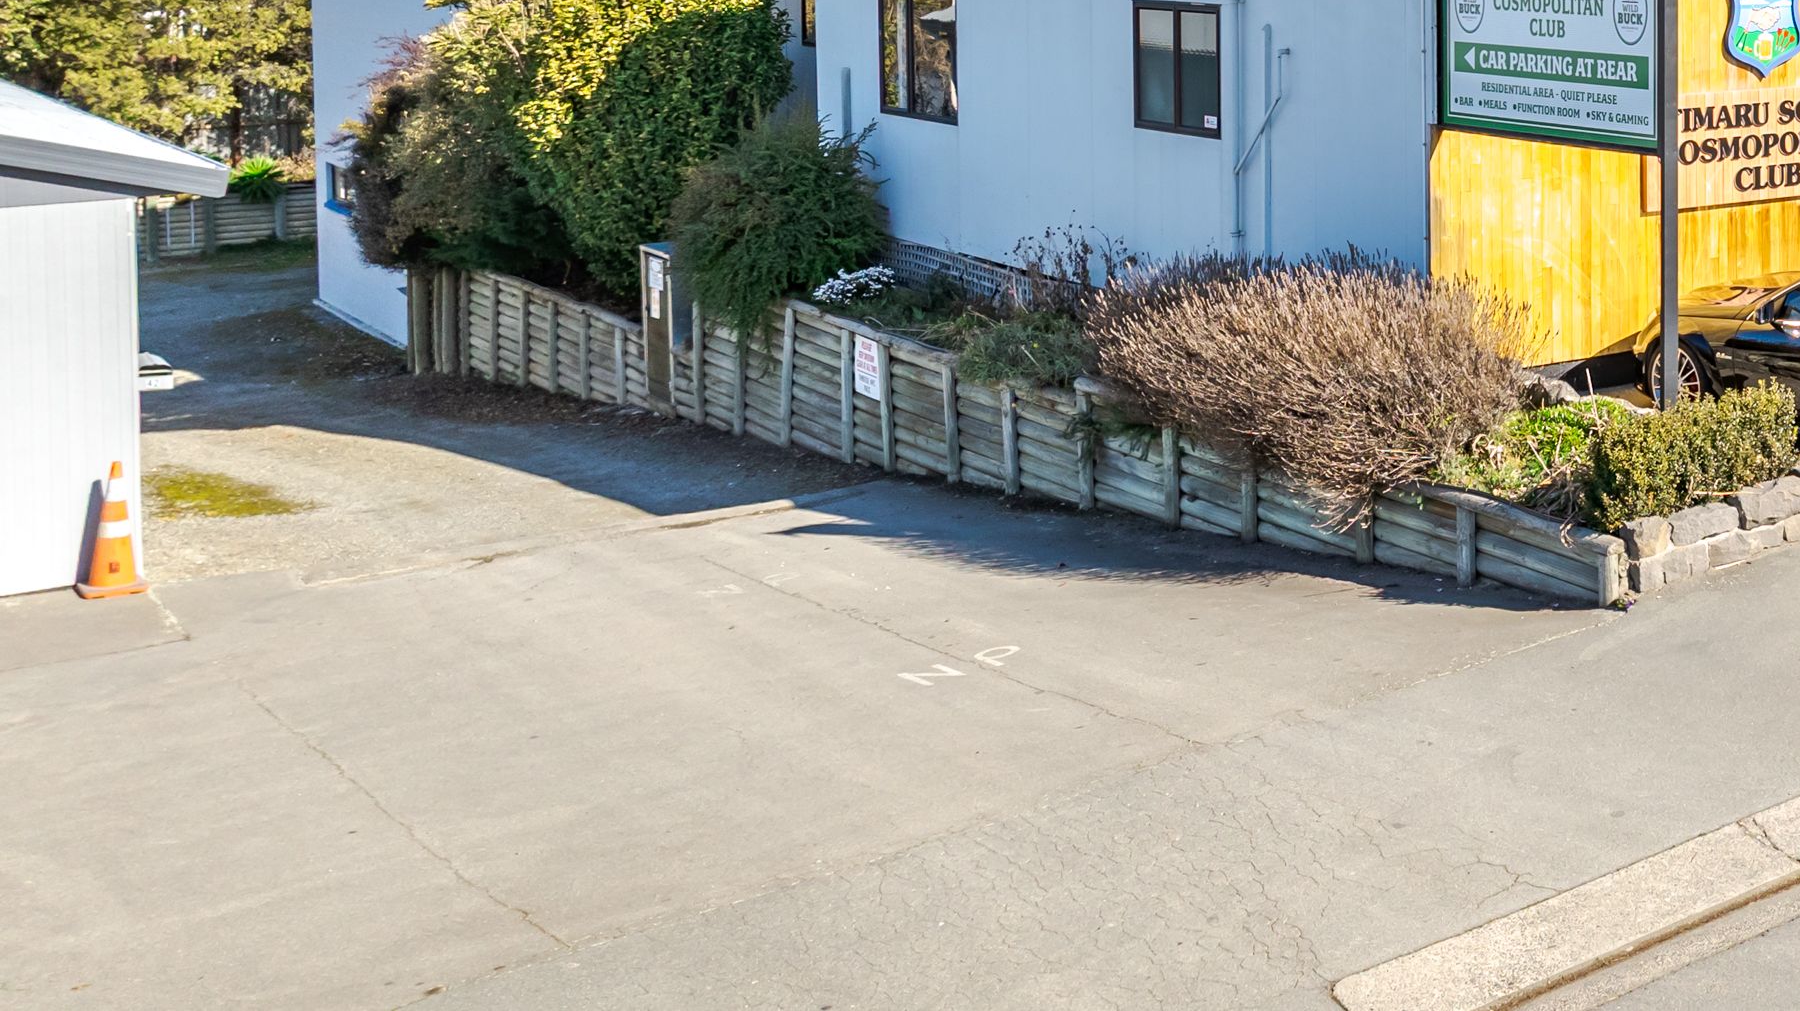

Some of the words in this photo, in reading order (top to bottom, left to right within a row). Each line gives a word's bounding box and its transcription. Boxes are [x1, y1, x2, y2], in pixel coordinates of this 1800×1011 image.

[1459, 3, 1480, 14] BUCK
[1617, 12, 1643, 25] BUCK
[1622, 4, 1639, 12] WILD
[1529, 18, 1565, 38] CLUB
[1479, 50, 1507, 70] CAR
[1509, 52, 1573, 76] PARKING
[1575, 58, 1594, 78] AT
[1597, 59, 1637, 82] REAR
[1481, 81, 1531, 96] RESIDENTIAL
[1533, 86, 1554, 98] AREA
[1560, 89, 1585, 102] QUIET
[1587, 92, 1617, 105] PLEASE
[1459, 96, 1473, 106] BAR
[1483, 99, 1507, 110] MEALS
[1517, 103, 1555, 115] FUNCTION
[1557, 107, 1580, 118] ROOM
[1591, 110, 1607, 121] SKY
[1608, 112, 1614, 122] &
[1615, 113, 1649, 126] GAMING
[1678, 101, 1770, 133] IMARU
